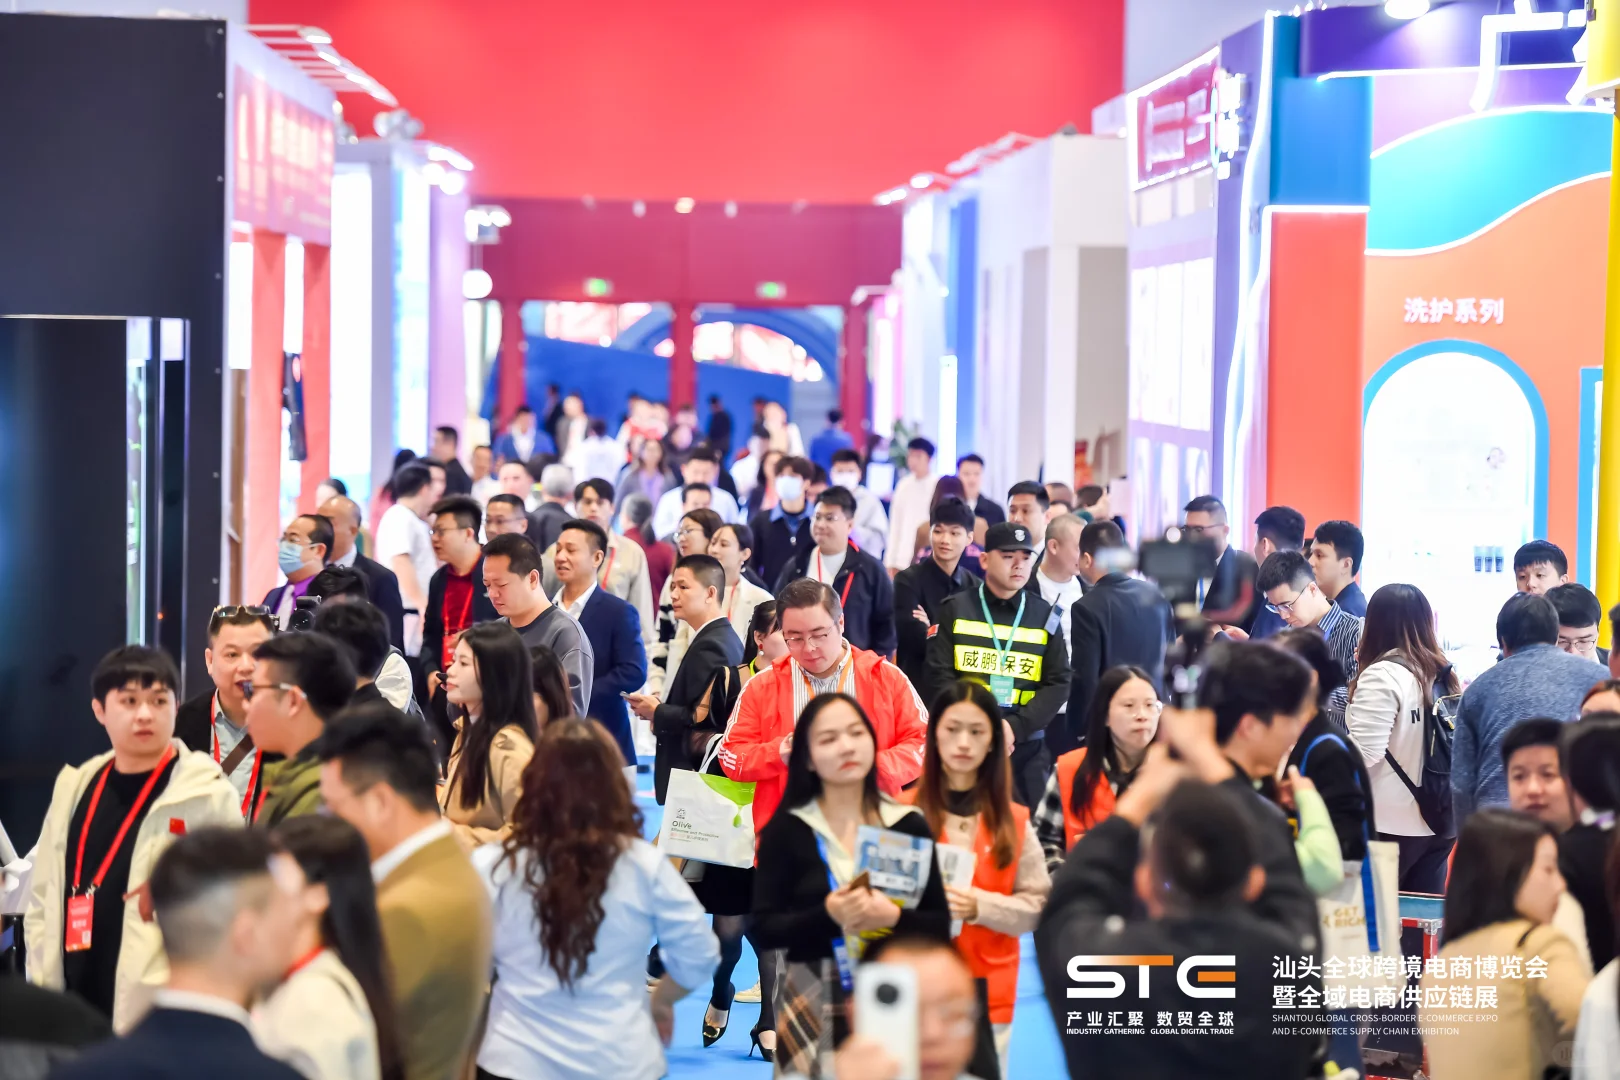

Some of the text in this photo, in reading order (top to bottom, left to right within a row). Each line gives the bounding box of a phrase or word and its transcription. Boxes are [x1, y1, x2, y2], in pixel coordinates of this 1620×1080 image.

[1404, 297, 1504, 324] 洗护系列
[671, 820, 692, 830] Olive
